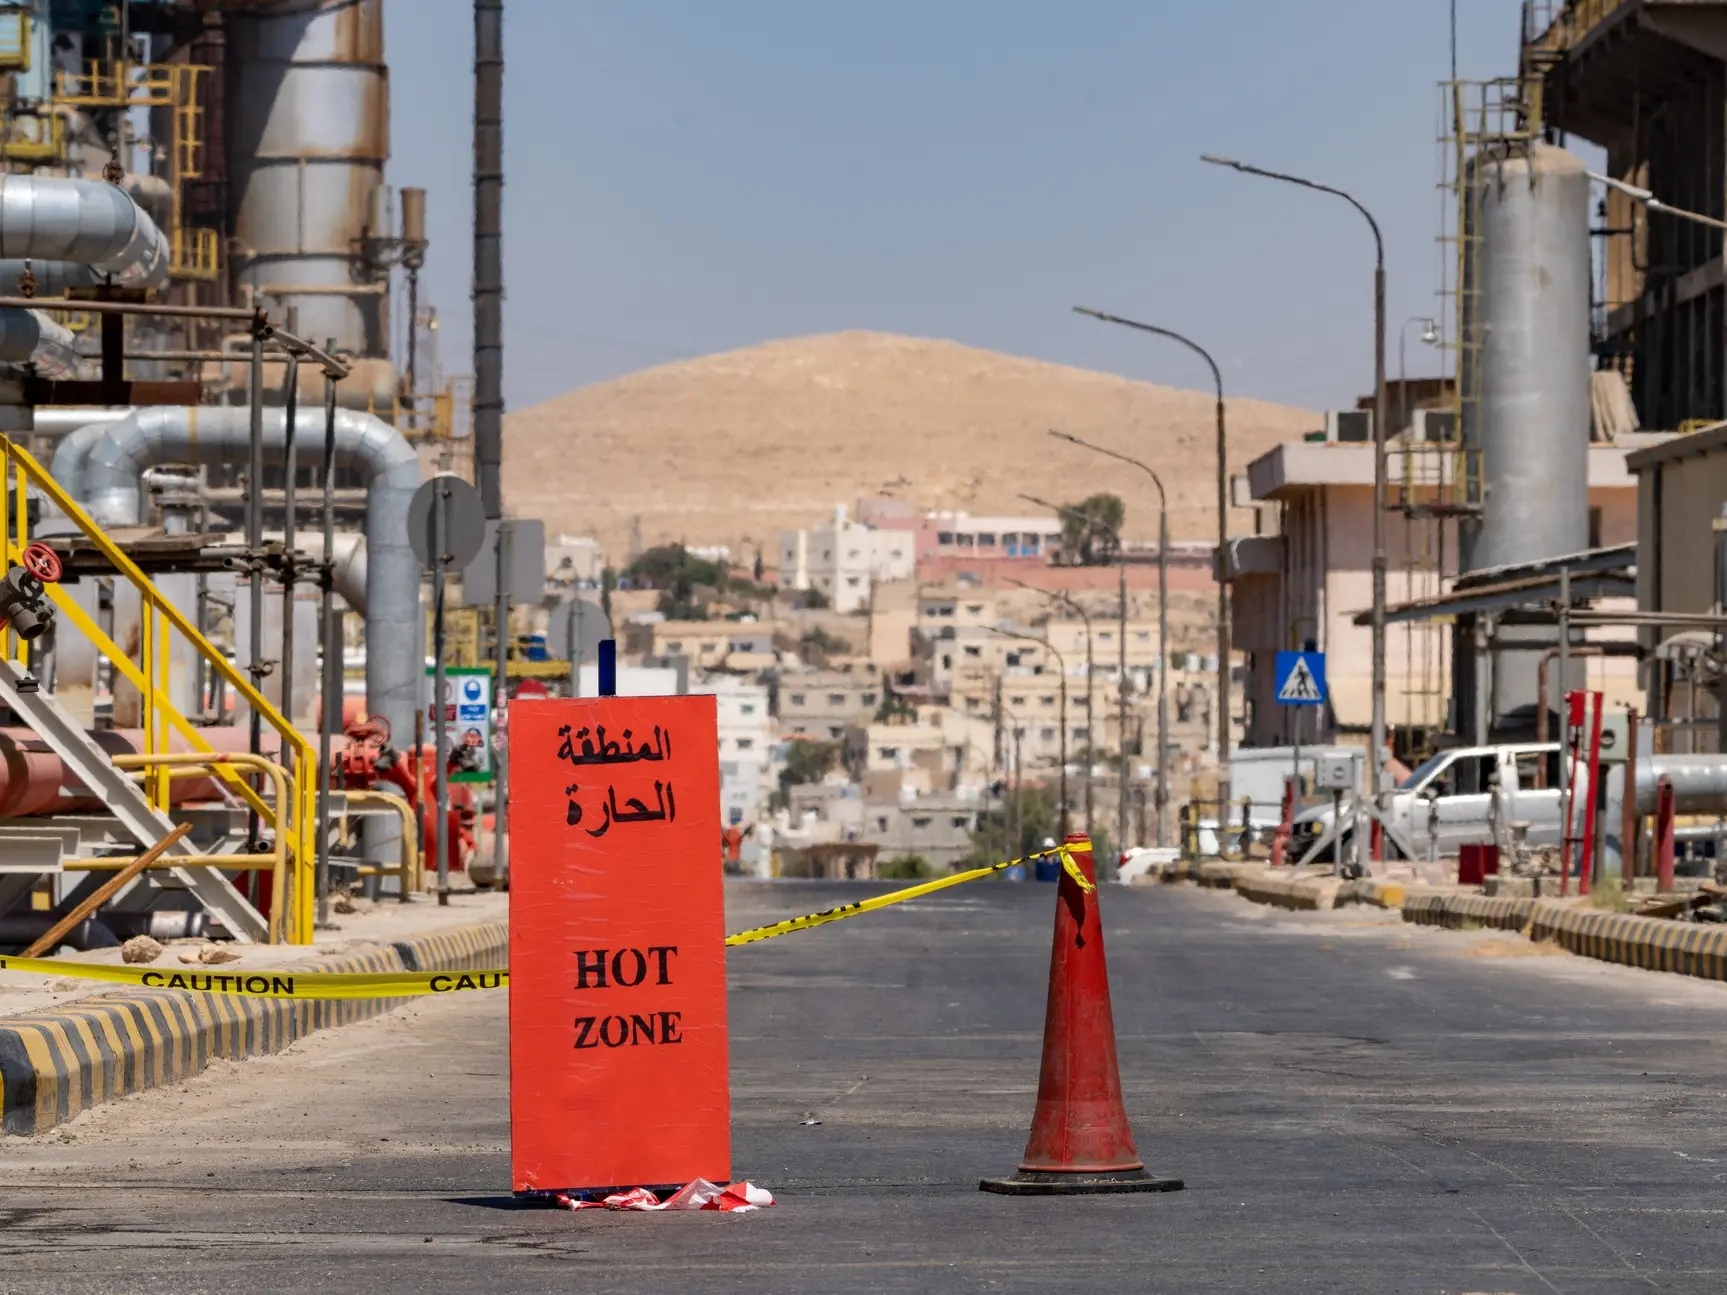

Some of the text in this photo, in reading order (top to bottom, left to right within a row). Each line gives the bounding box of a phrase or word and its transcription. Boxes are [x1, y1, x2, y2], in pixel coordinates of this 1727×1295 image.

[557, 724, 671, 765] المنطقة
[566, 779, 676, 838] الحارة
[141, 972, 510, 995] CAUTION CAU
[573, 946, 678, 990] HOT
[573, 1011, 683, 1049] ZONE
